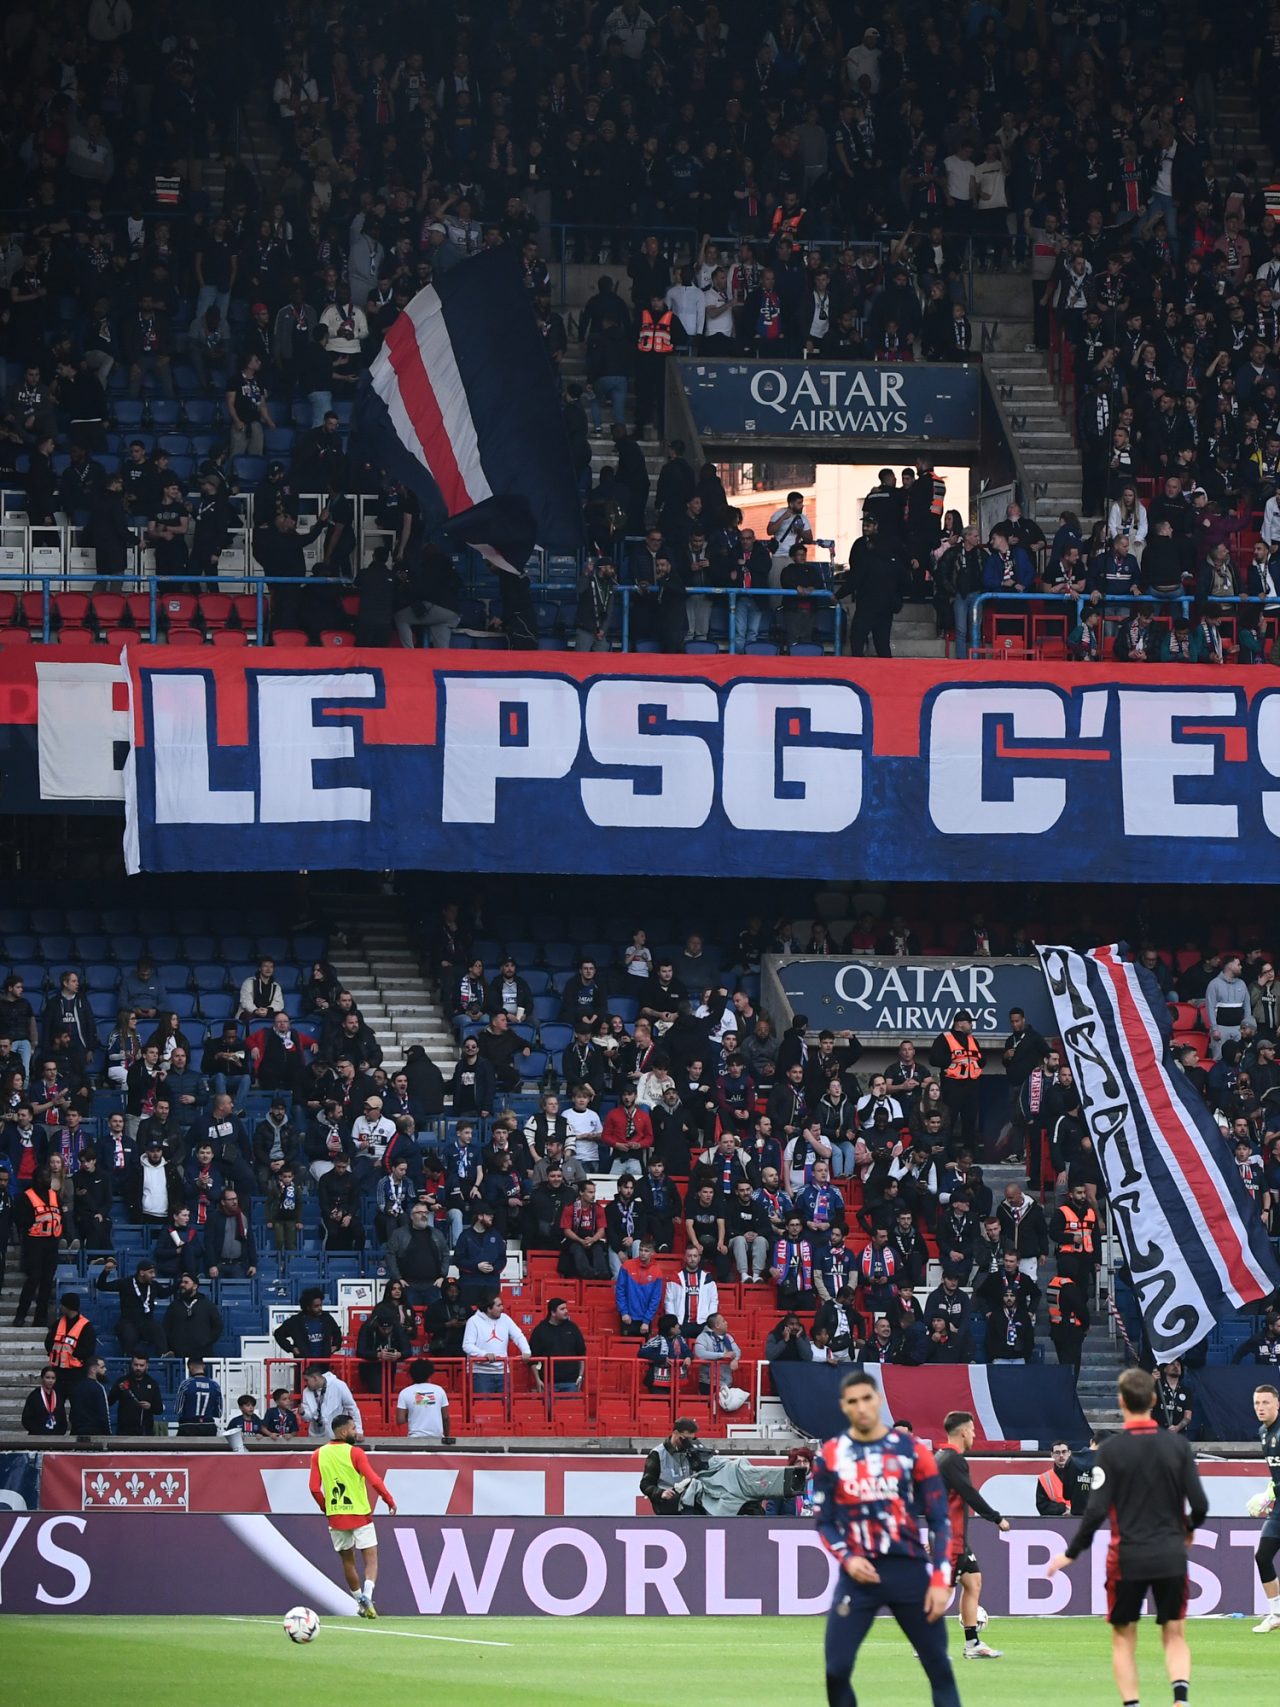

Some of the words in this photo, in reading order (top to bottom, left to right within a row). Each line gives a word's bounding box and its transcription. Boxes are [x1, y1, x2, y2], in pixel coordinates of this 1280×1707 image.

[750, 369, 907, 413] QATAR
[790, 410, 908, 433] AIRWAYS
[150, 672, 376, 825] LE
[441, 675, 864, 833] PSG
[834, 964, 998, 1011] QATAR
[875, 1007, 998, 1030] AIRWYS
[195, 1391, 210, 1416] 17
